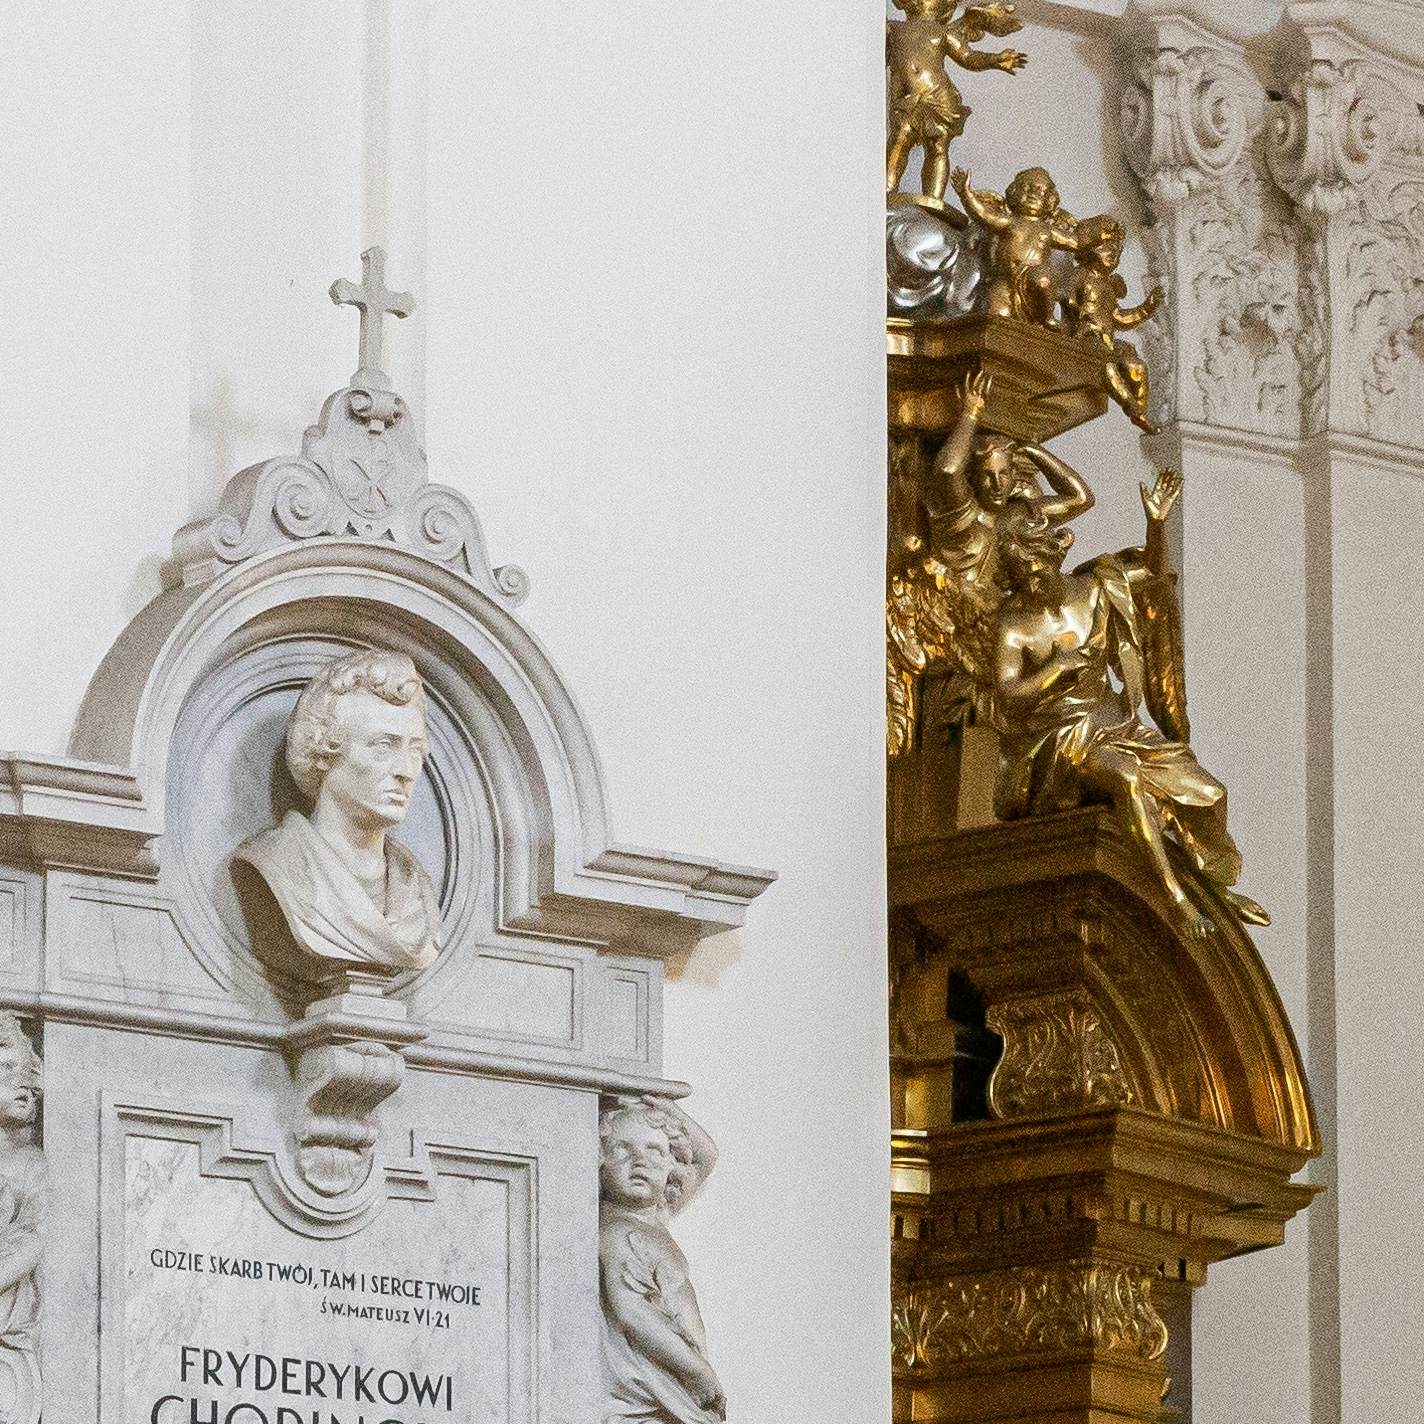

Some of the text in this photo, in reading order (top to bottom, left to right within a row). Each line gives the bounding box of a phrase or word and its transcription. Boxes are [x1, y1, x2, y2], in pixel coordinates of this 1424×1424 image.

[150, 1249, 204, 1273] GDZIE
[209, 1256, 263, 1279] SKARB
[320, 1269, 356, 1291] TAM
[361, 1273, 365, 1293] I
[371, 1276, 423, 1299] SERCE
[181, 1346, 452, 1411] FRYDERYKOWI
